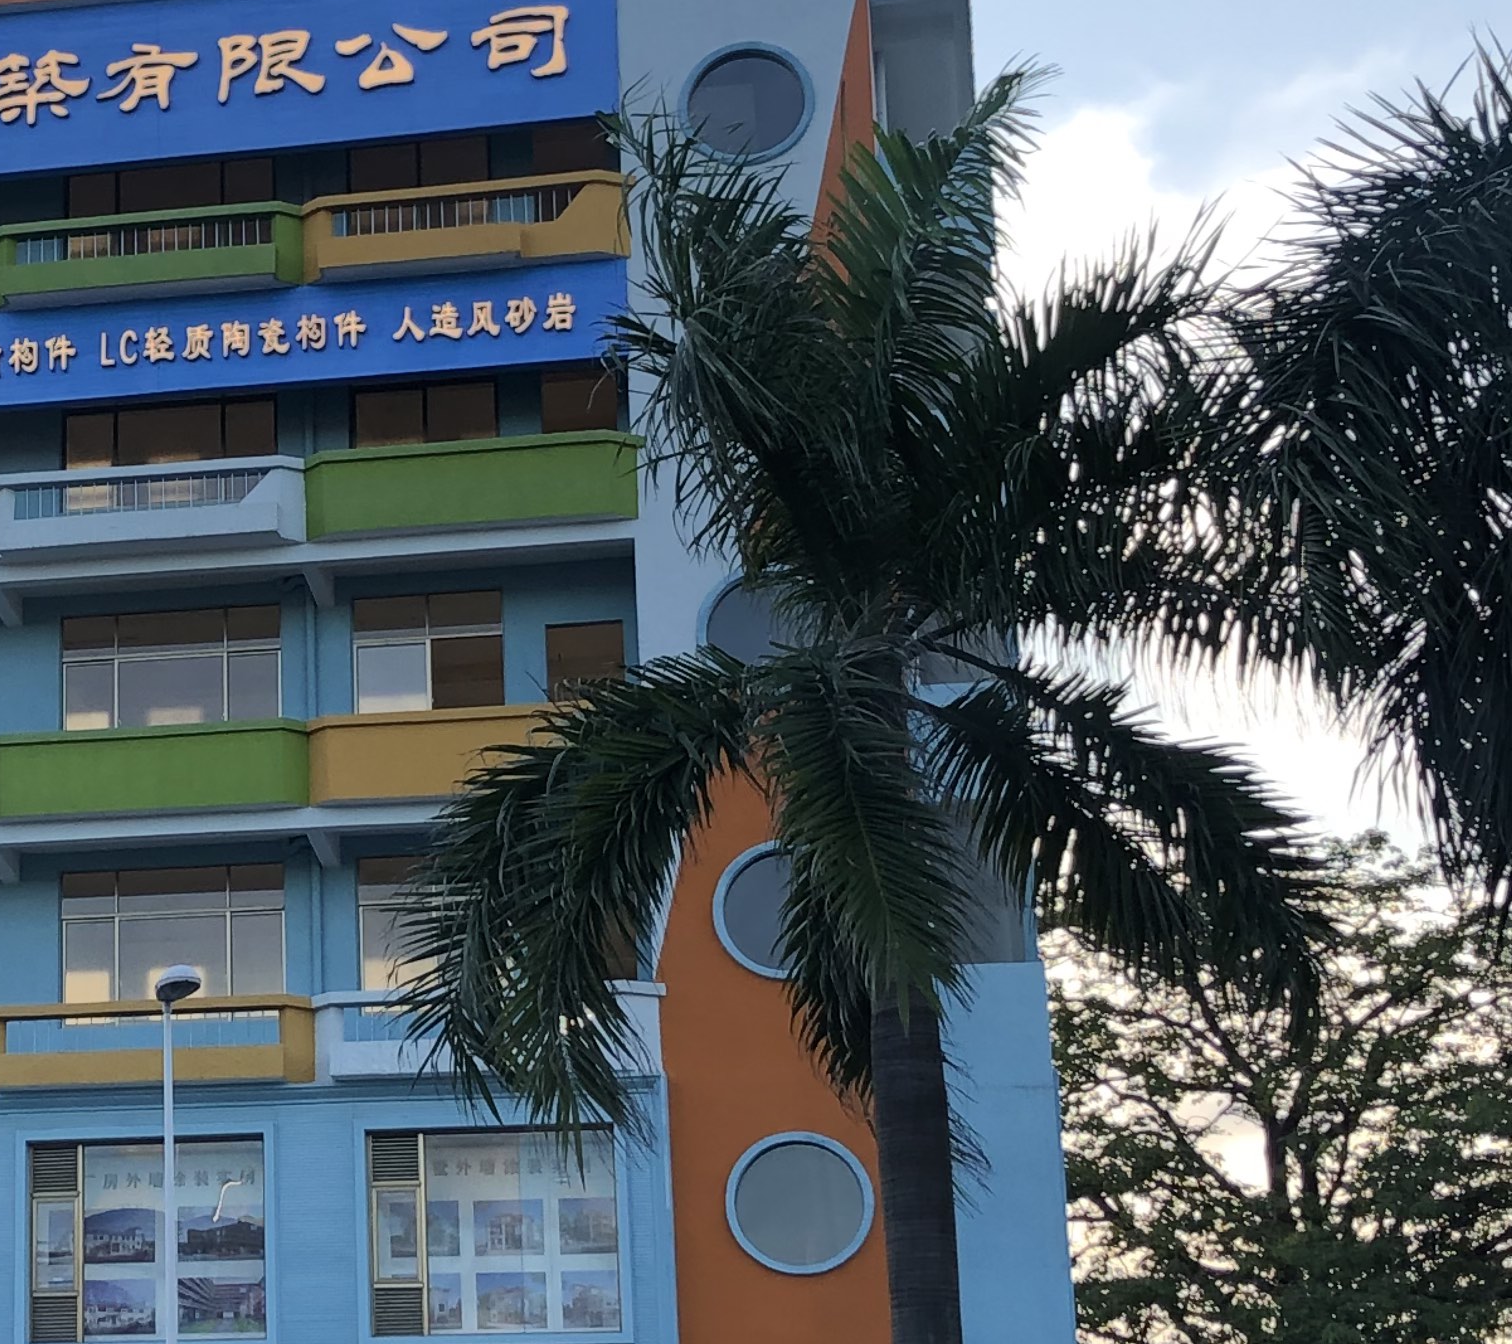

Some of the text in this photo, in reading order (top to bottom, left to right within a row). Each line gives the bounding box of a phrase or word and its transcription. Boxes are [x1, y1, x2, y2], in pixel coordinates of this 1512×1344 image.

[100, 311, 367, 367] LC轻质陶瓷构件
[392, 293, 576, 342] 人造风砂岩
